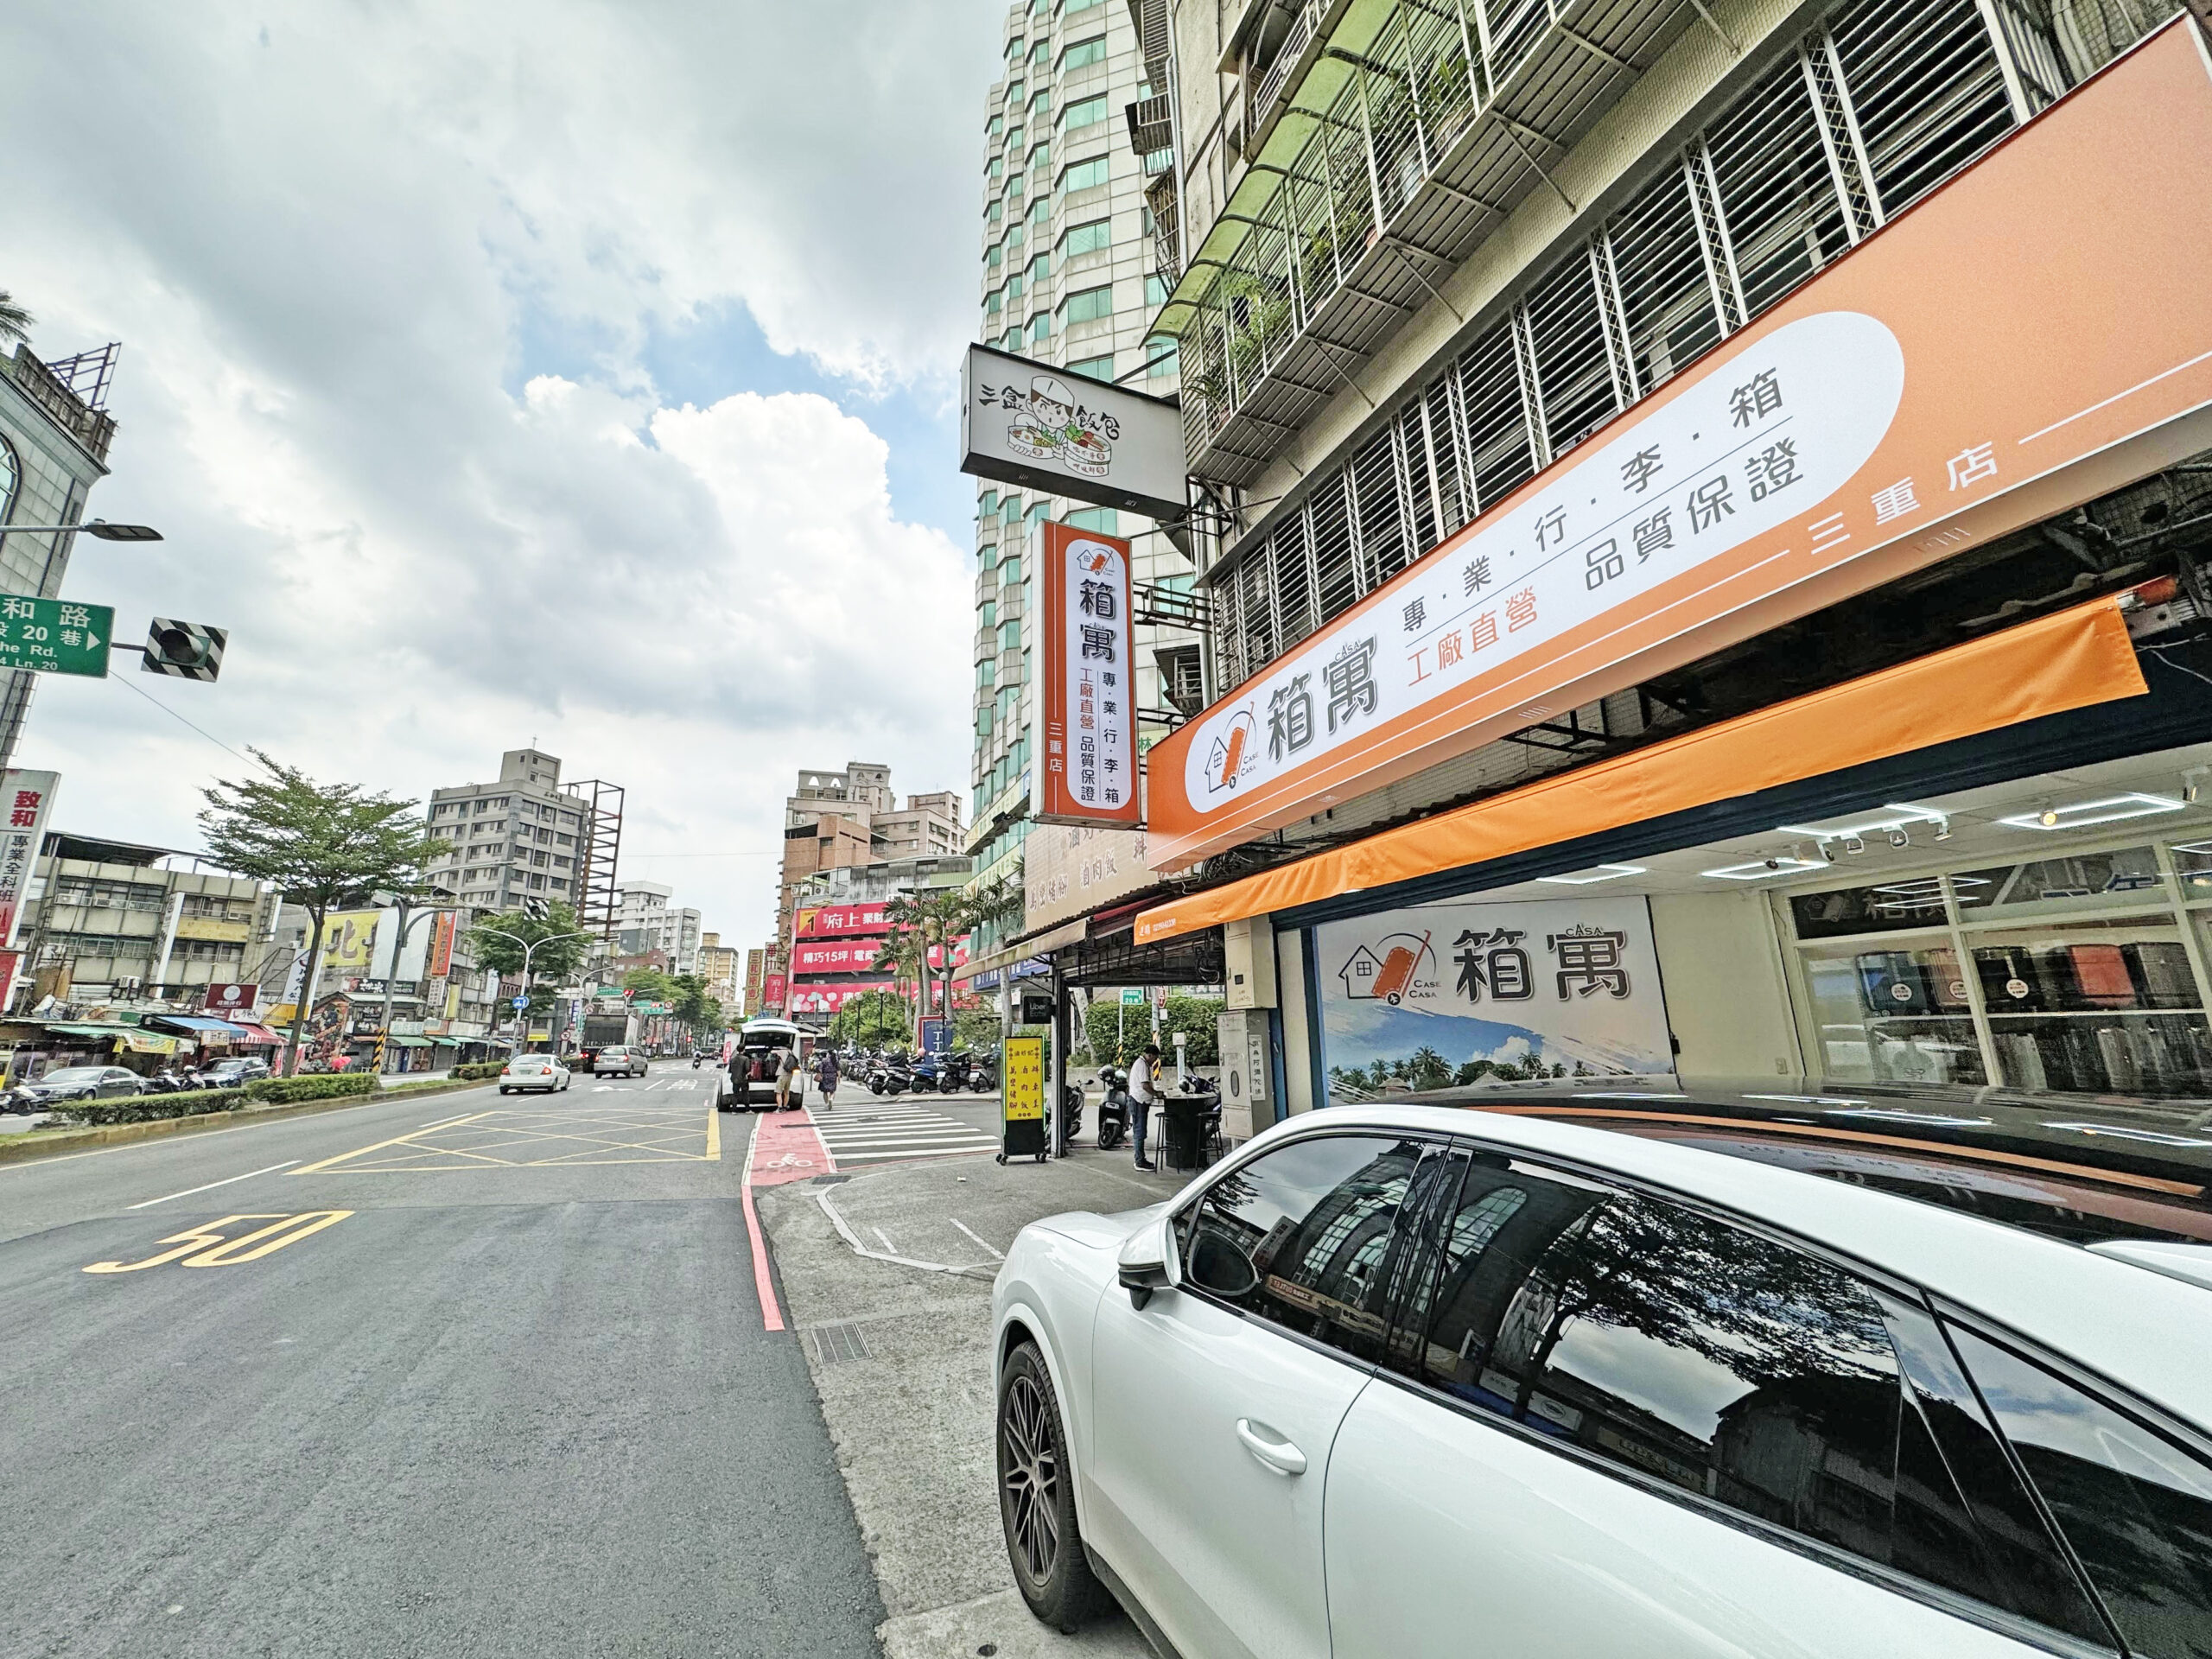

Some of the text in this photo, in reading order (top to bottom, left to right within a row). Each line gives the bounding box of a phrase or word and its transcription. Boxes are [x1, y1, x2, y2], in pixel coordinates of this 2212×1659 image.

[1808, 441, 1999, 555] 三重店
[1407, 435, 1803, 688] 工廠直營 品質保證
[30, 645, 58, 658] Rd.
[1079, 578, 1116, 663] 箱寓
[15, 658, 37, 669] Ln.
[41, 661, 58, 671] 20
[1266, 633, 1377, 765] 箱寓
[1048, 721, 1063, 772] 三重店
[1079, 668, 1096, 802] 工廠直營 品質保證
[10, 791, 42, 828] 致和
[0, 835, 29, 903] 專業全科班
[1408, 989, 1437, 998] CASA
[1414, 980, 1441, 988] CASE
[1452, 926, 1631, 1004] 箱寓
[81, 1210, 357, 1274] 50
